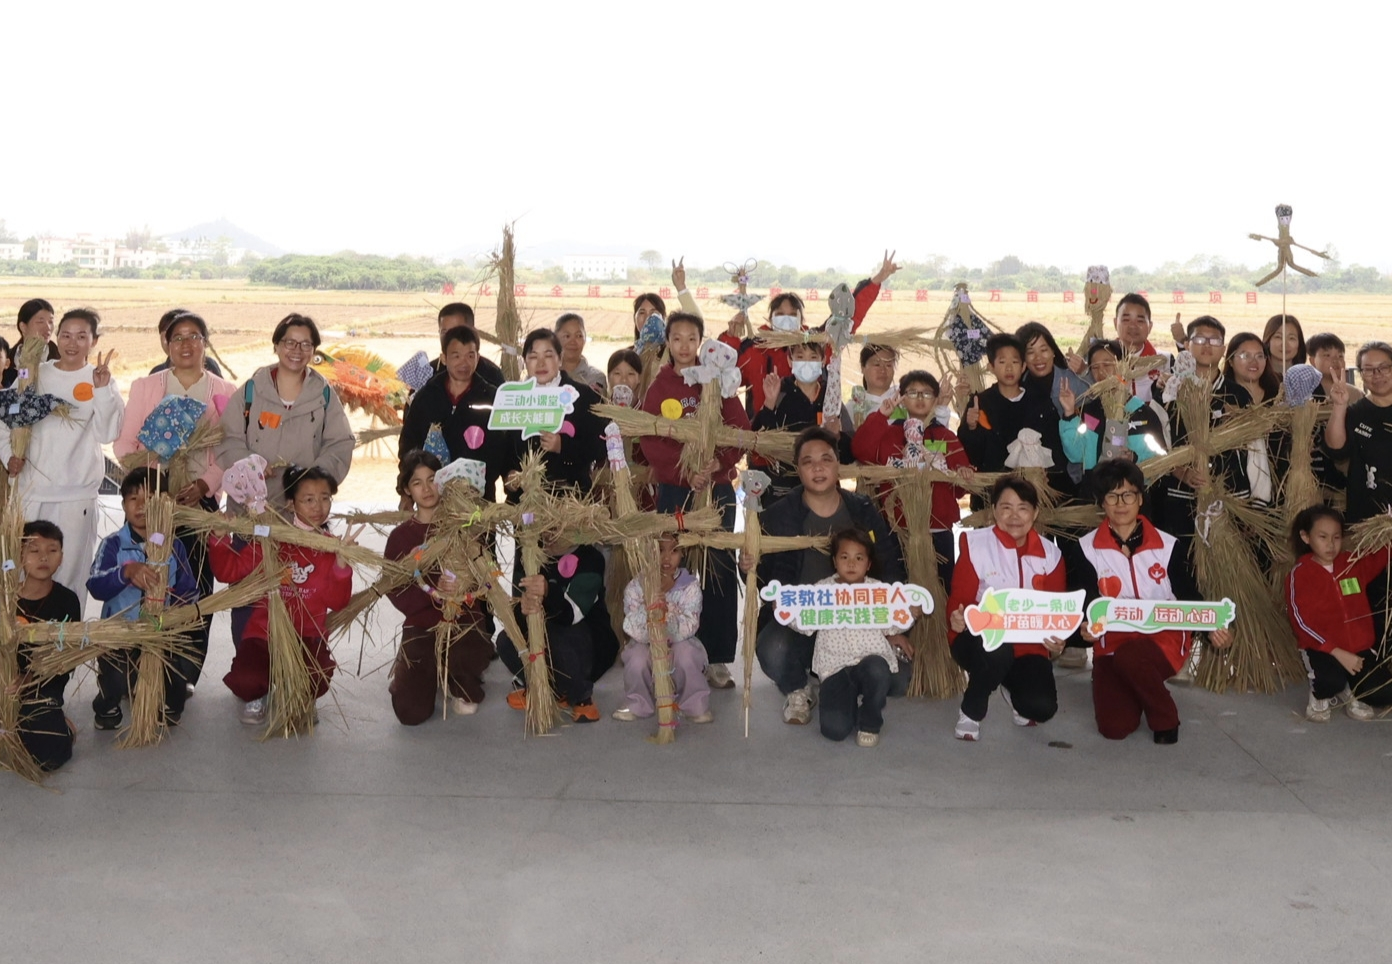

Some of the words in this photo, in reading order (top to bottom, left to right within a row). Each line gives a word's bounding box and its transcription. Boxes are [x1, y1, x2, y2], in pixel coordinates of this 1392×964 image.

[504, 394, 559, 407] 三动小课堂
[500, 411, 554, 424] 成长大能量
[1359, 422, 1373, 433] CUTE
[780, 587, 907, 607] 家教社协同育人
[1008, 598, 1076, 612] 老少一条心
[799, 607, 889, 626] 健康实践营
[1114, 606, 1143, 621] 劳动
[1003, 615, 1071, 630] 护苗暖人心
